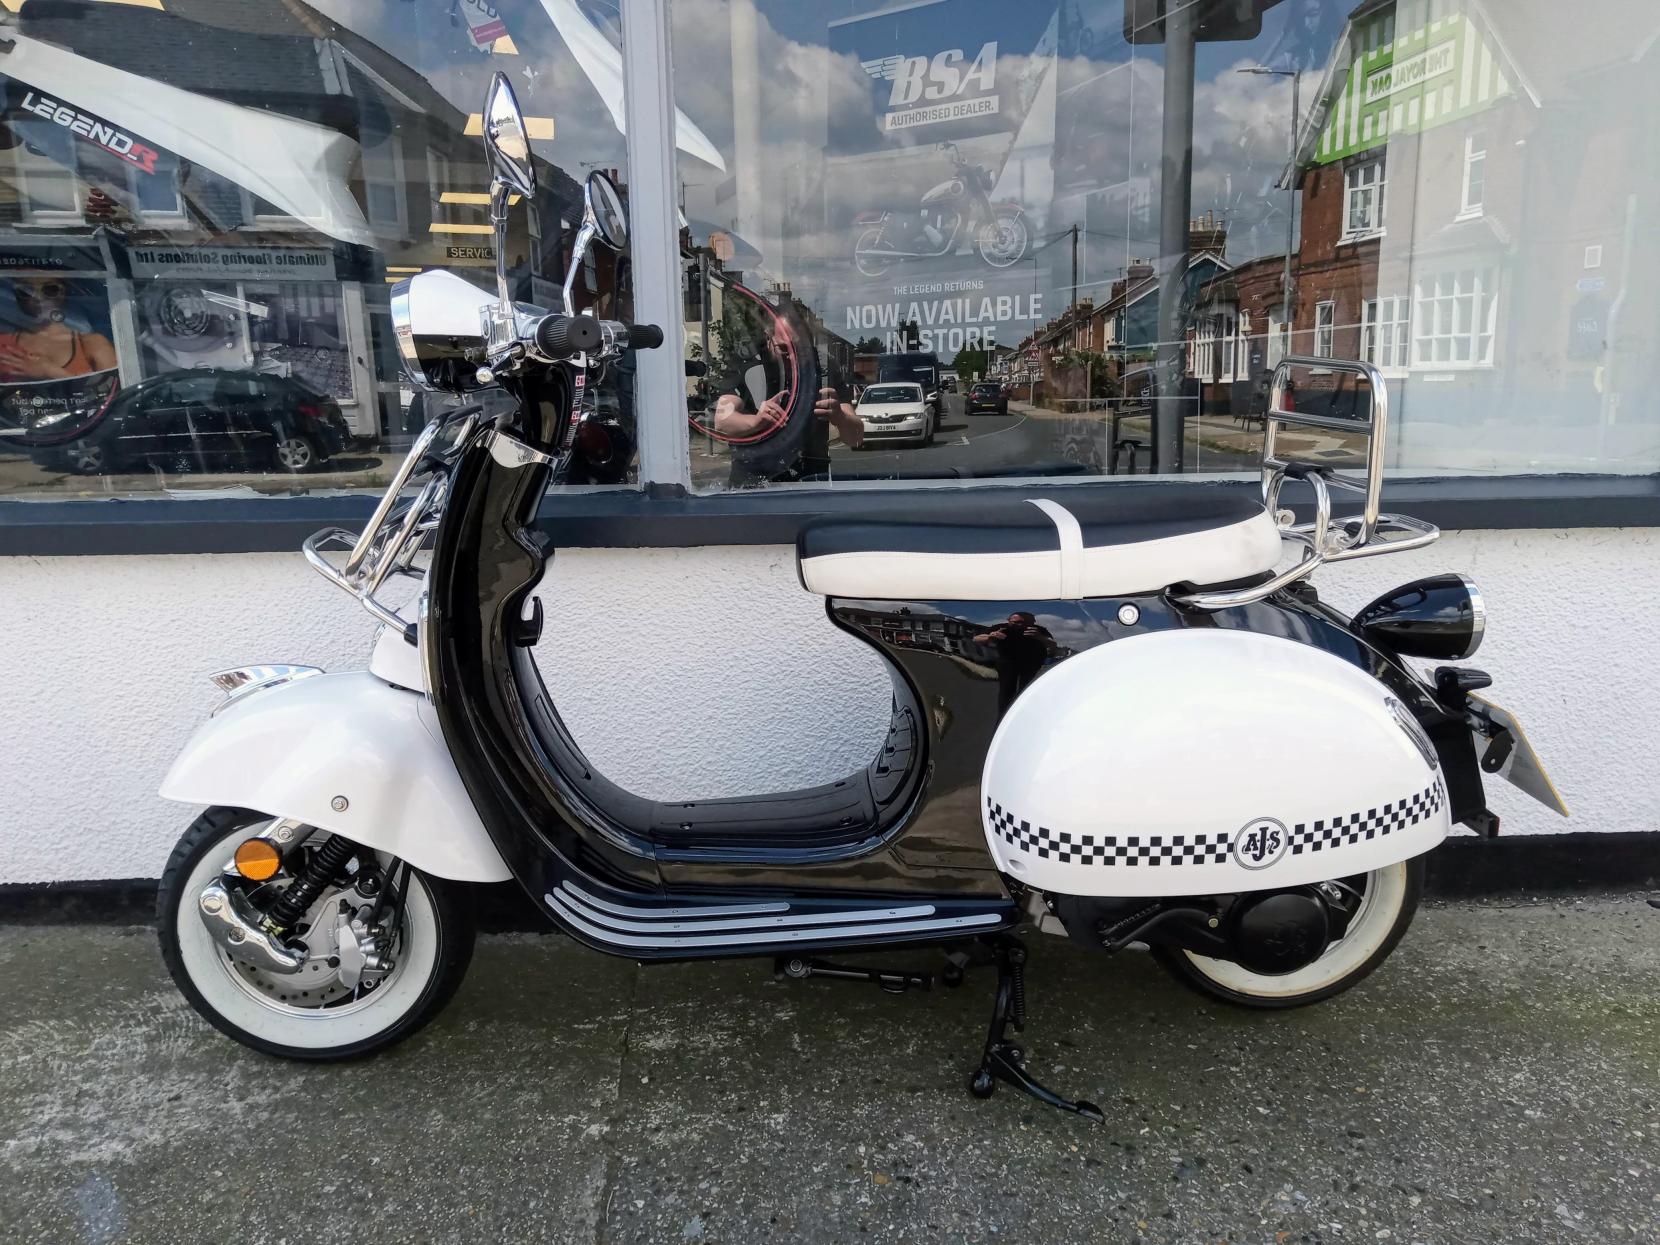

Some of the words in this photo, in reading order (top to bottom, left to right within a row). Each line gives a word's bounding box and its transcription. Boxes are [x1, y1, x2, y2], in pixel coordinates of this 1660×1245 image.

[888, 41, 998, 106] BSA
[890, 107, 951, 127] AUTHORISED
[952, 100, 994, 117] DEALER.
[893, 285, 908, 295] THE
[909, 283, 942, 294] LEGEND
[944, 280, 984, 292] RETURNS
[846, 303, 900, 330] NOW
[906, 293, 1044, 326] AVAILABLE
[886, 326, 997, 355] IN-STORE
[1241, 826, 1281, 862] AJS
